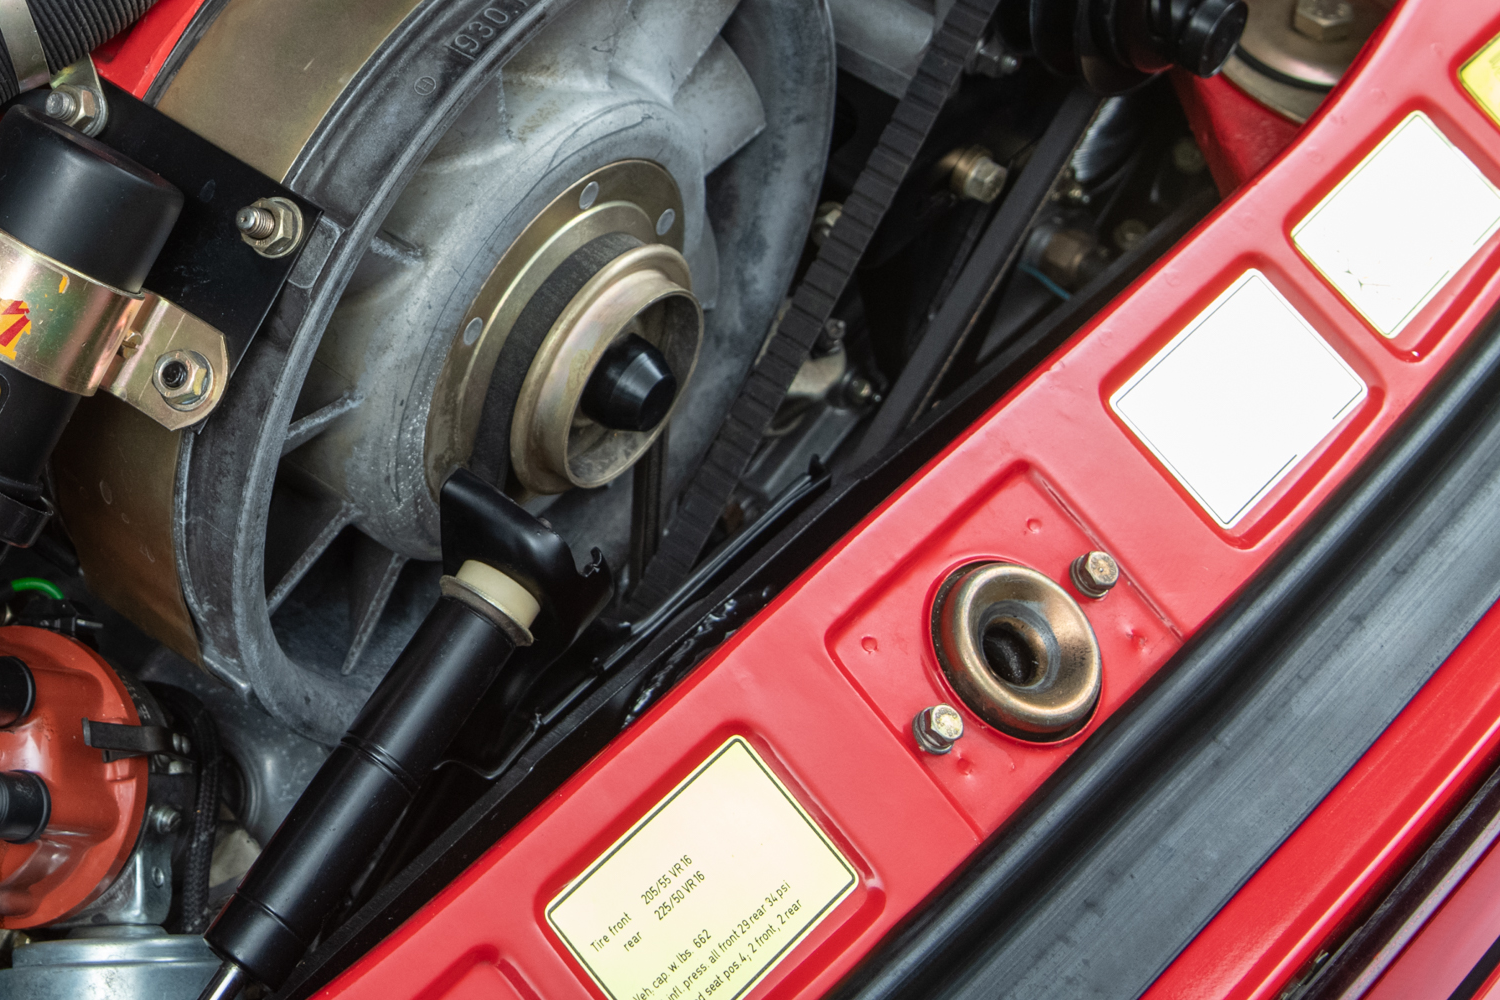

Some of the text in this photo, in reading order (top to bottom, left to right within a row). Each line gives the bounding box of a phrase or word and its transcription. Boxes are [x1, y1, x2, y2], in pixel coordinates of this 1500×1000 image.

[590, 934, 610, 952] Tire
[608, 911, 632, 936] front
[641, 874, 672, 905] 205/55
[623, 931, 642, 952] rear
[654, 889, 685, 921] 225/50
[683, 963, 710, 991] press.
[708, 948, 721, 964] all
[717, 929, 740, 953] front
[737, 919, 751, 935] 29
[749, 904, 767, 924] rear
[764, 893, 779, 907] 34
[776, 879, 791, 900] psi
[705, 974, 724, 996] seat
[747, 942, 757, 954] 2
[754, 923, 781, 948] front,
[776, 913, 786, 925] 2
[784, 899, 802, 920] rear
[652, 972, 671, 989] cap.
[667, 961, 680, 973] w.
[676, 949, 695, 964] lbs.
[693, 929, 712, 949] 662
